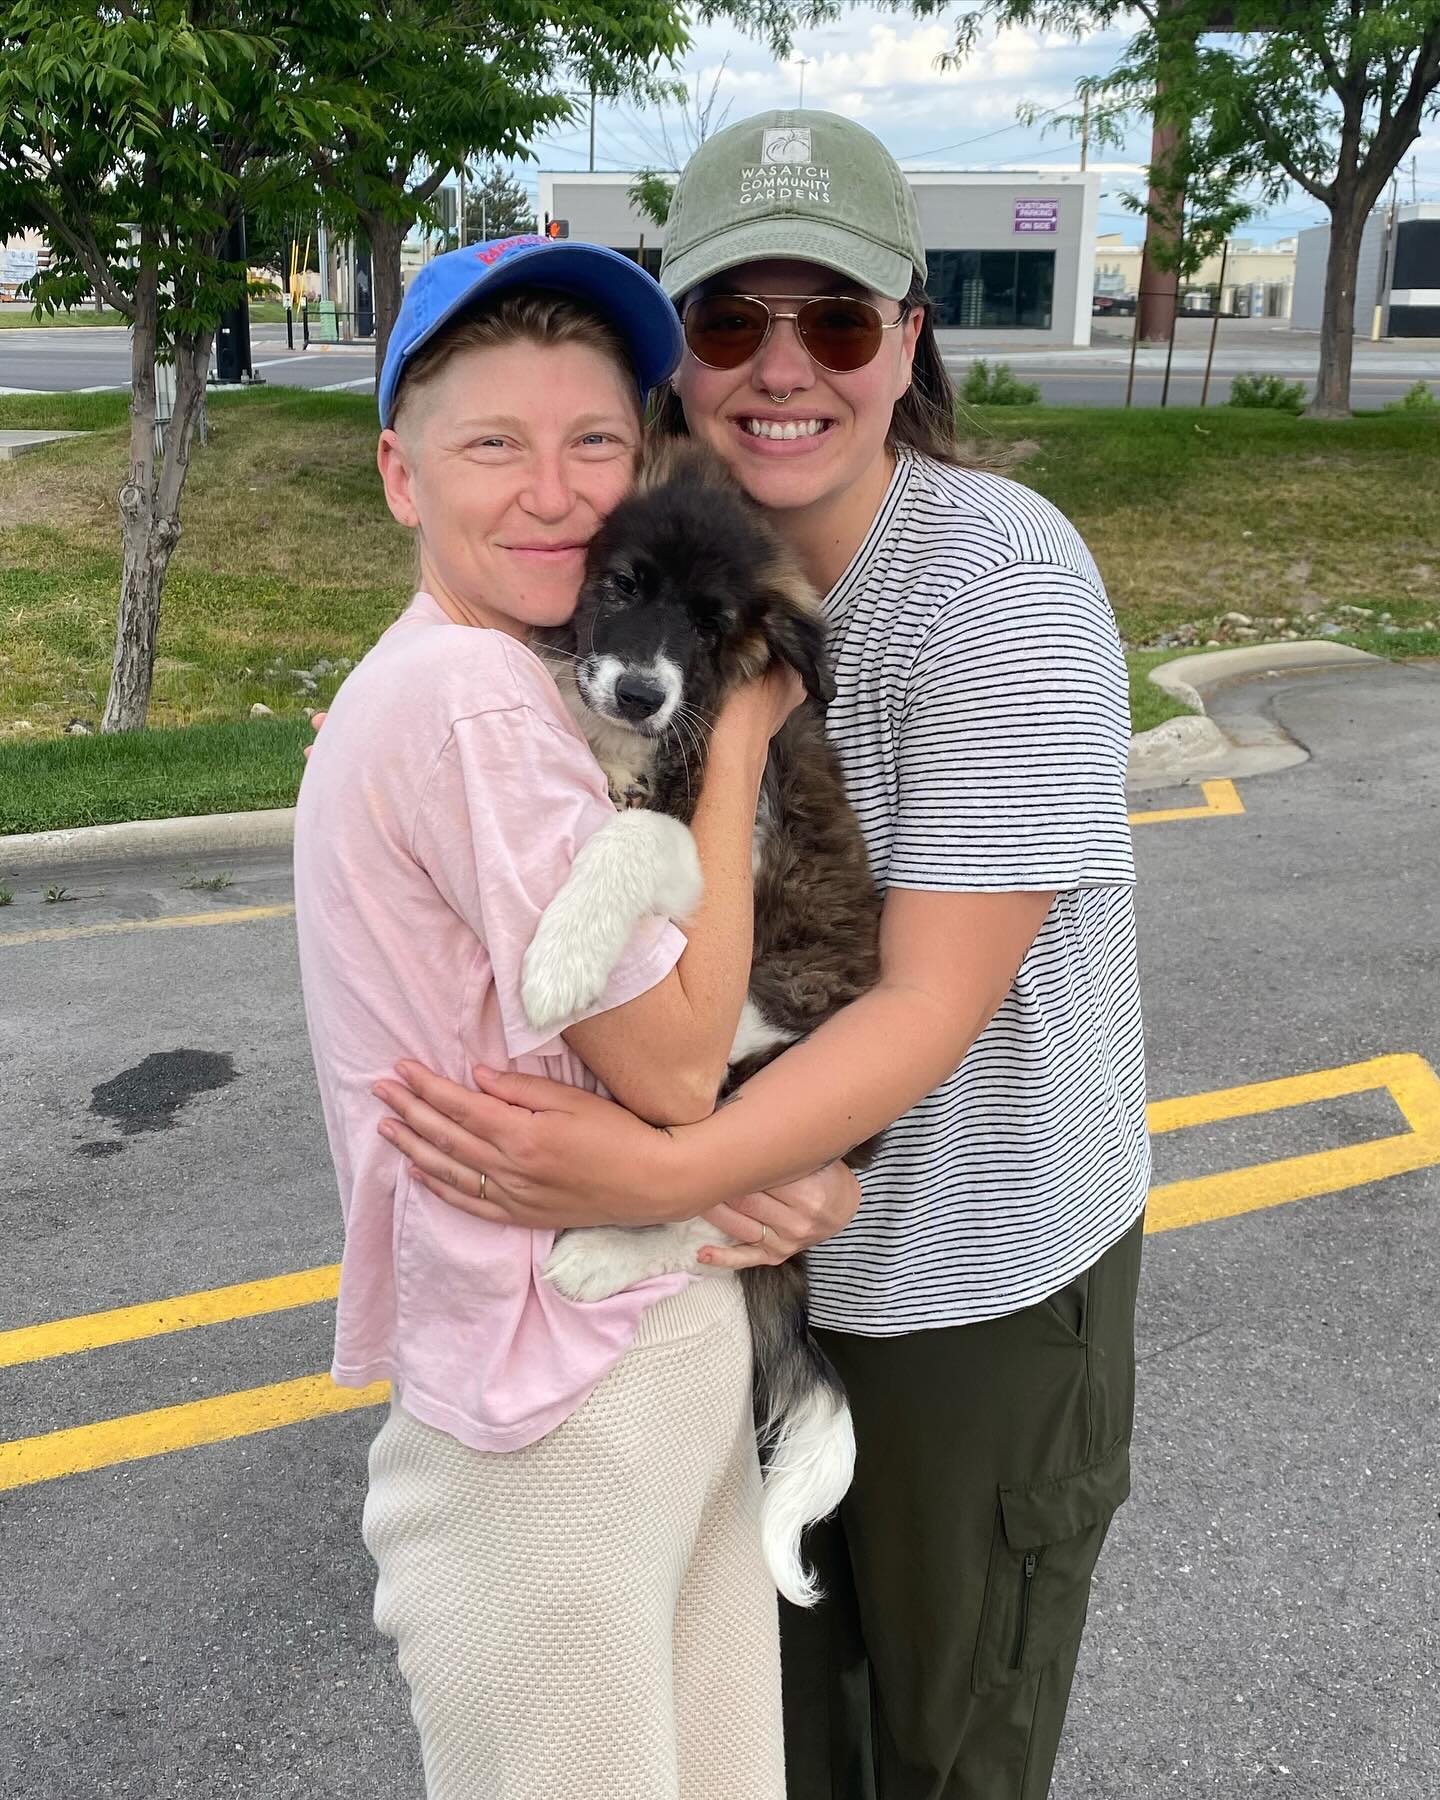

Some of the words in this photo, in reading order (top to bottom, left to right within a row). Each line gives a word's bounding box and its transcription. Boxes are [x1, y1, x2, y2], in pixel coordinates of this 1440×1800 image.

[741, 165, 830, 179] WASATCH
[741, 177, 830, 192] COMMUNITY
[740, 188, 830, 204] GARDENS
